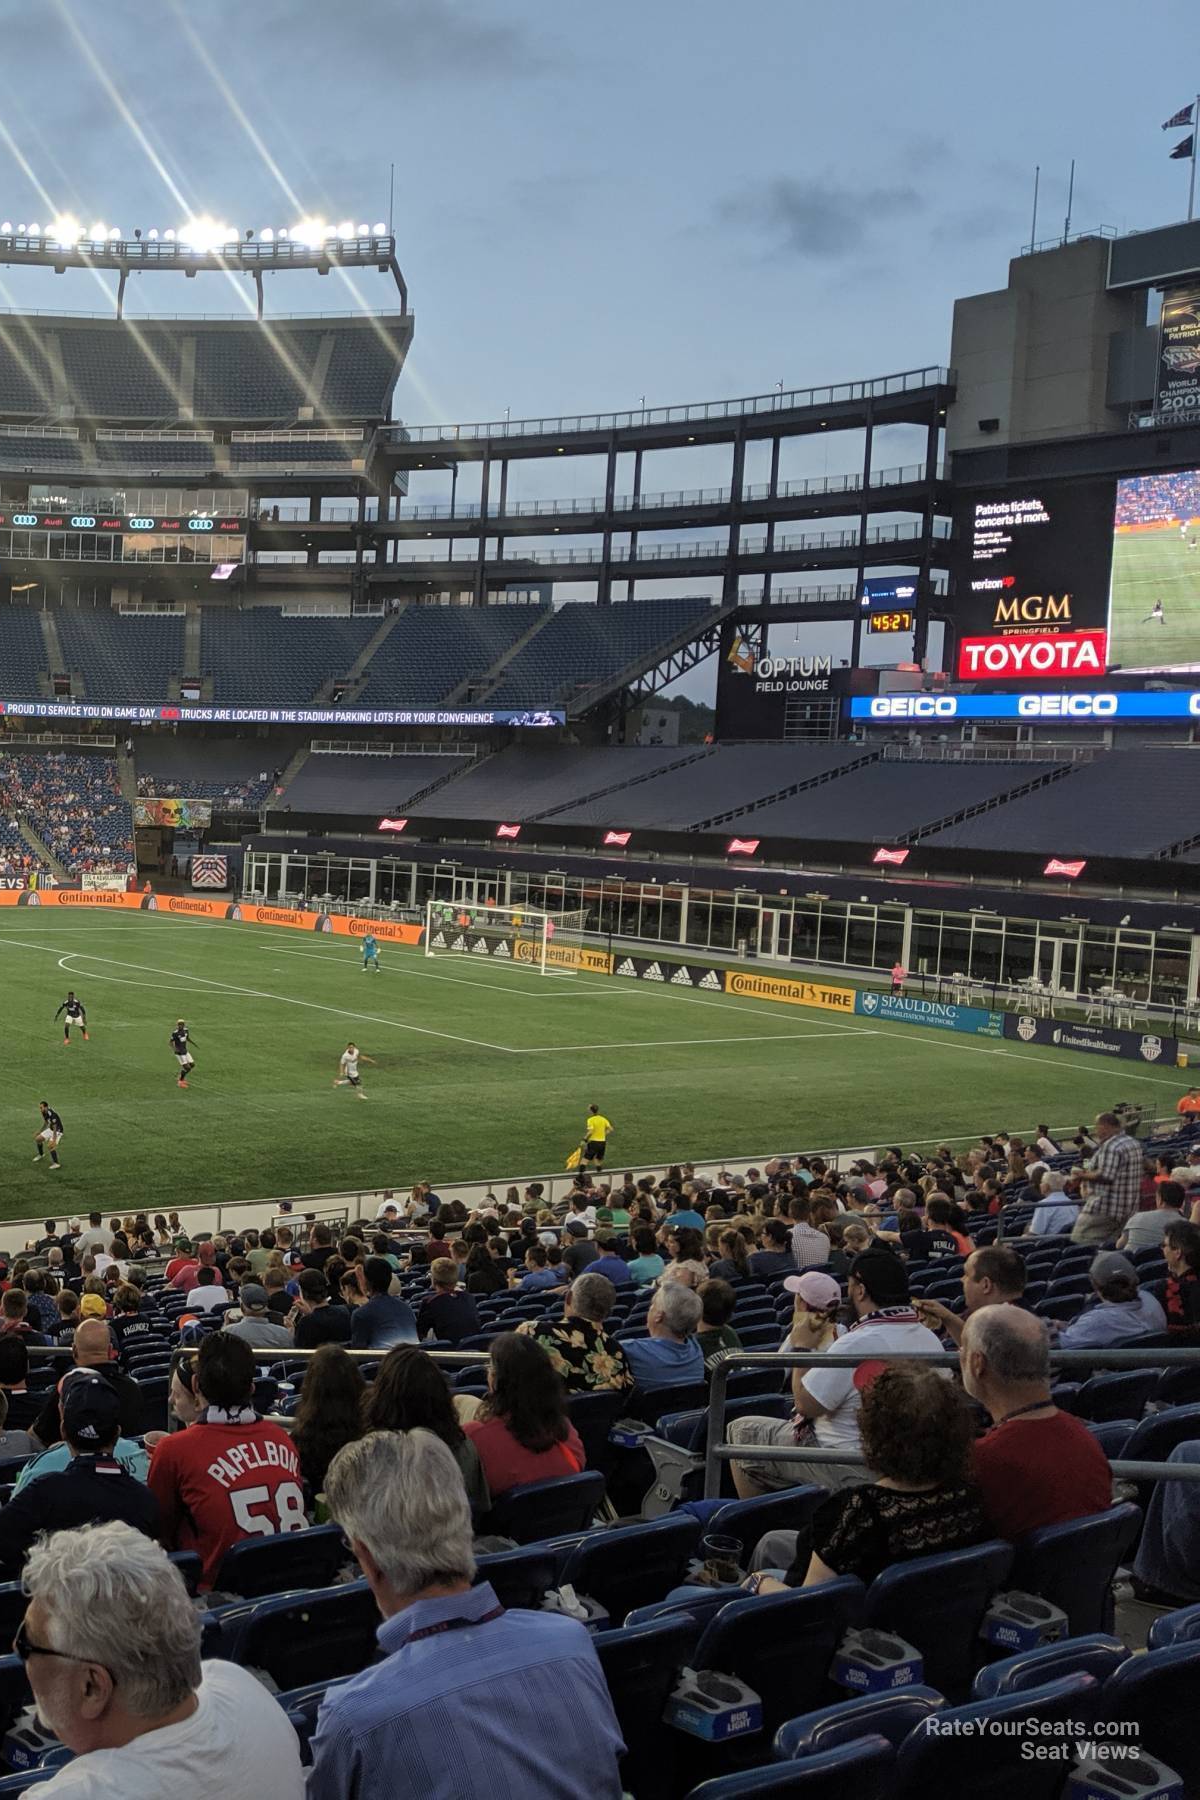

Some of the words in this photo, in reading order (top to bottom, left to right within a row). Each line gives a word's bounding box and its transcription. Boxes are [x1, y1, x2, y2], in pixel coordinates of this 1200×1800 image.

[975, 503, 1010, 516] Patriots
[1010, 499, 1044, 511] tickets,
[44, 518, 63, 527] Audi
[102, 520, 121, 528] Audi
[161, 520, 180, 529] Audi
[220, 521, 239, 530] Audi
[974, 516, 1014, 528] concerts
[1015, 513, 1022, 524] &
[1023, 511, 1050, 523] more.
[994, 595, 1071, 622] MGM
[873, 614, 909, 630] 45:27
[1003, 627, 1060, 636] SPRINGFIELD
[965, 641, 1099, 671] TOYOTA
[757, 655, 833, 679] OPTUM
[756, 681, 783, 693] FIELD
[786, 680, 829, 691] LOUNGE
[871, 697, 957, 717] GEICO
[1018, 694, 1118, 716] GEICO
[8, 703, 34, 715] PROUD
[36, 704, 47, 716] TO
[48, 705, 83, 716] SERVICE
[83, 706, 100, 717] YOU
[101, 706, 113, 717] ON
[115, 707, 137, 718] GAME
[139, 708, 158, 718] DAY.
[180, 709, 213, 719] TRUCKS
[215, 709, 231, 720] ARE
[232, 710, 268, 720] LOCATED
[270, 710, 279, 721] IN
[281, 711, 297, 721] THE
[298, 711, 333, 721] STADIUM
[335, 711, 372, 722] PARKING
[373, 712, 394, 722] LOTS
[395, 712, 412, 722] FOR
[413, 712, 436, 723] YOUR
[437, 713, 494, 723] CONVENIENCE
[58, 891, 116, 905] Continental
[169, 898, 207, 913] Continental
[256, 907, 298, 925] Continental
[348, 919, 396, 938] Continental
[586, 956, 610, 969] TIRE
[616, 968, 638, 977] adidas
[643, 972, 664, 981] adidas
[671, 977, 693, 986] adidas
[698, 981, 722, 990] adidas
[731, 974, 805, 999] Continental
[820, 992, 851, 1006] TIRE
[882, 995, 956, 1018] SPAULDING
[927, 1016, 955, 1026] NETWORK
[1062, 1035, 1121, 1052] UnitedHealthcare
[207, 1440, 299, 1489] PAPELBON
[660, 1488, 667, 1498] 19
[230, 1481, 310, 1536] 58
[996, 1632, 1021, 1644] LIGHT
[1000, 1627, 1017, 1637] BUD
[731, 1710, 748, 1722] BUD
[727, 1717, 751, 1732] LIGHT
